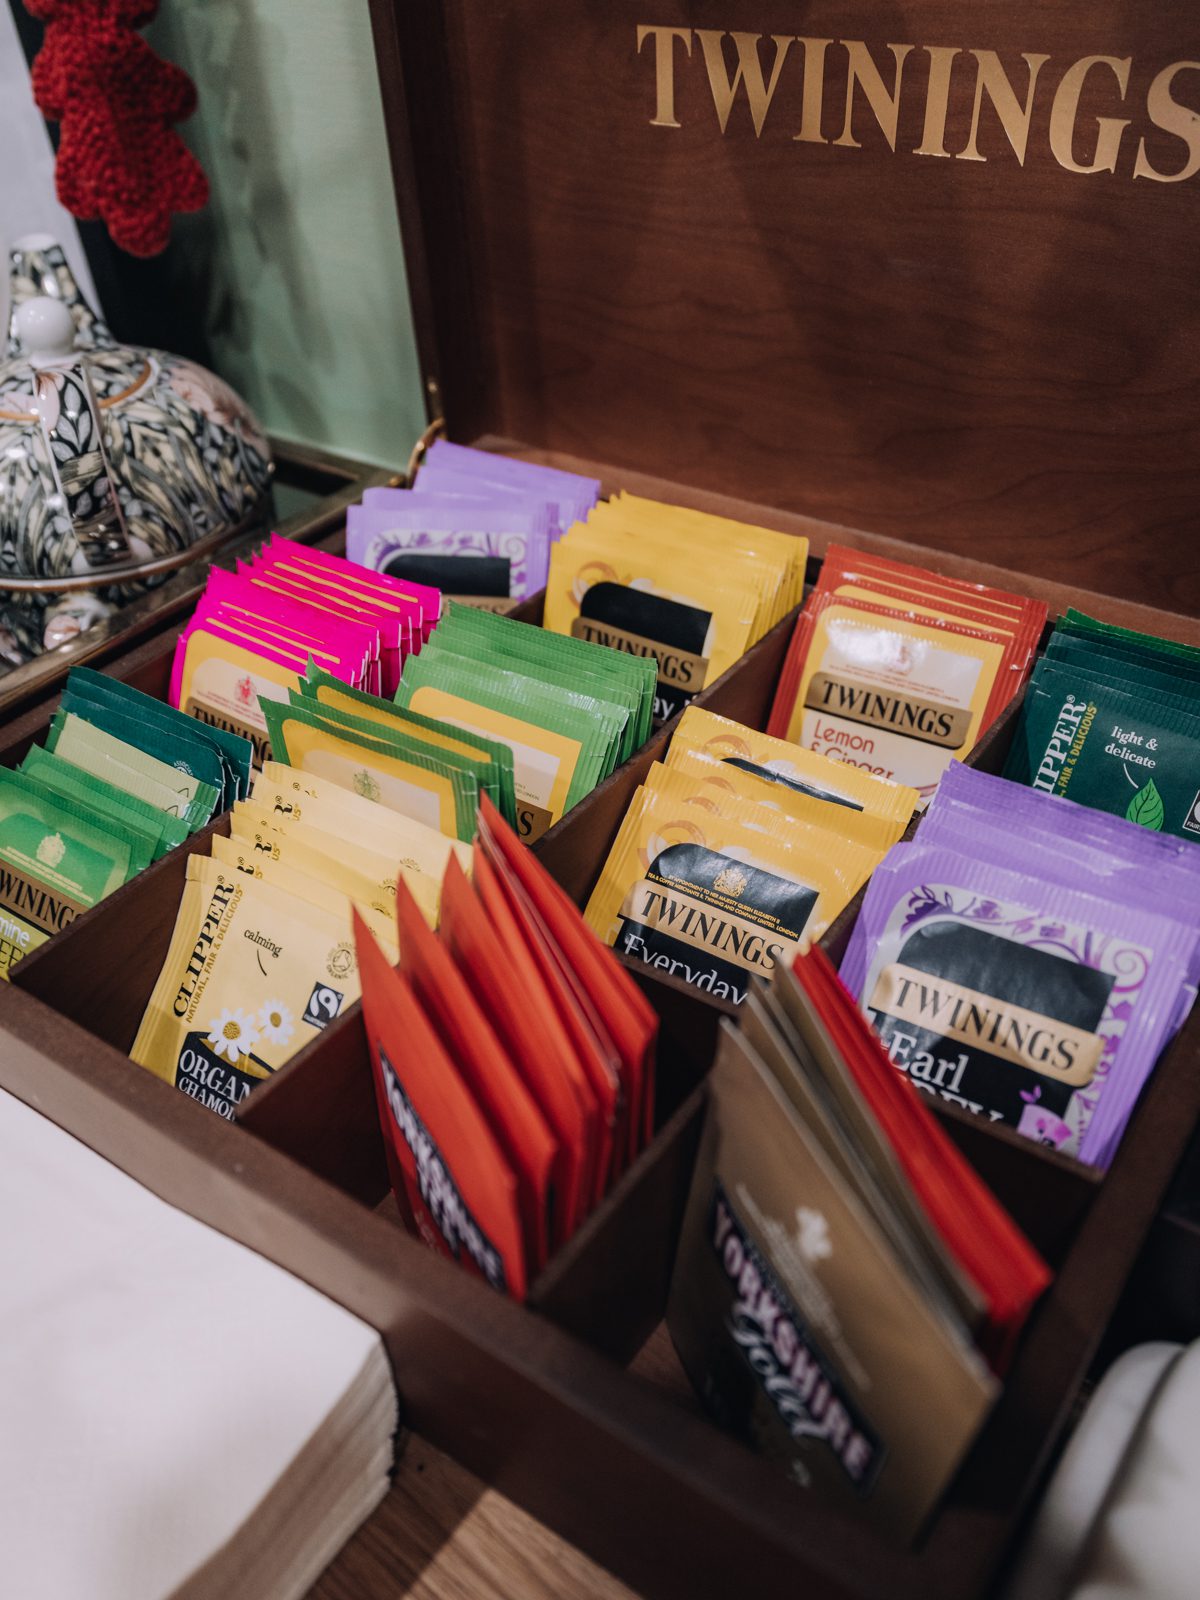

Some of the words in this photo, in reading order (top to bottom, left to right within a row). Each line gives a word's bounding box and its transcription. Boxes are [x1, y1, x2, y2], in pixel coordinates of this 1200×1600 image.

[637, 25, 1200, 182] TWININGS
[814, 719, 874, 754] Lemon
[822, 680, 954, 737] TWININGS
[1105, 743, 1156, 769] delicate
[1111, 726, 1144, 746] light
[1145, 738, 1158, 751] &
[1058, 766, 1073, 788] FAIR
[0, 868, 83, 930] WINING
[244, 929, 283, 958] calming
[639, 890, 784, 970] TWININGS
[204, 953, 217, 974] FAIR
[896, 977, 1079, 1071] TWININGS
[180, 1049, 251, 1105] ORGAN
[889, 1030, 969, 1093] Earl
[179, 1076, 235, 1121] CHAMO
[714, 1202, 873, 1480] YORKSHIRE
